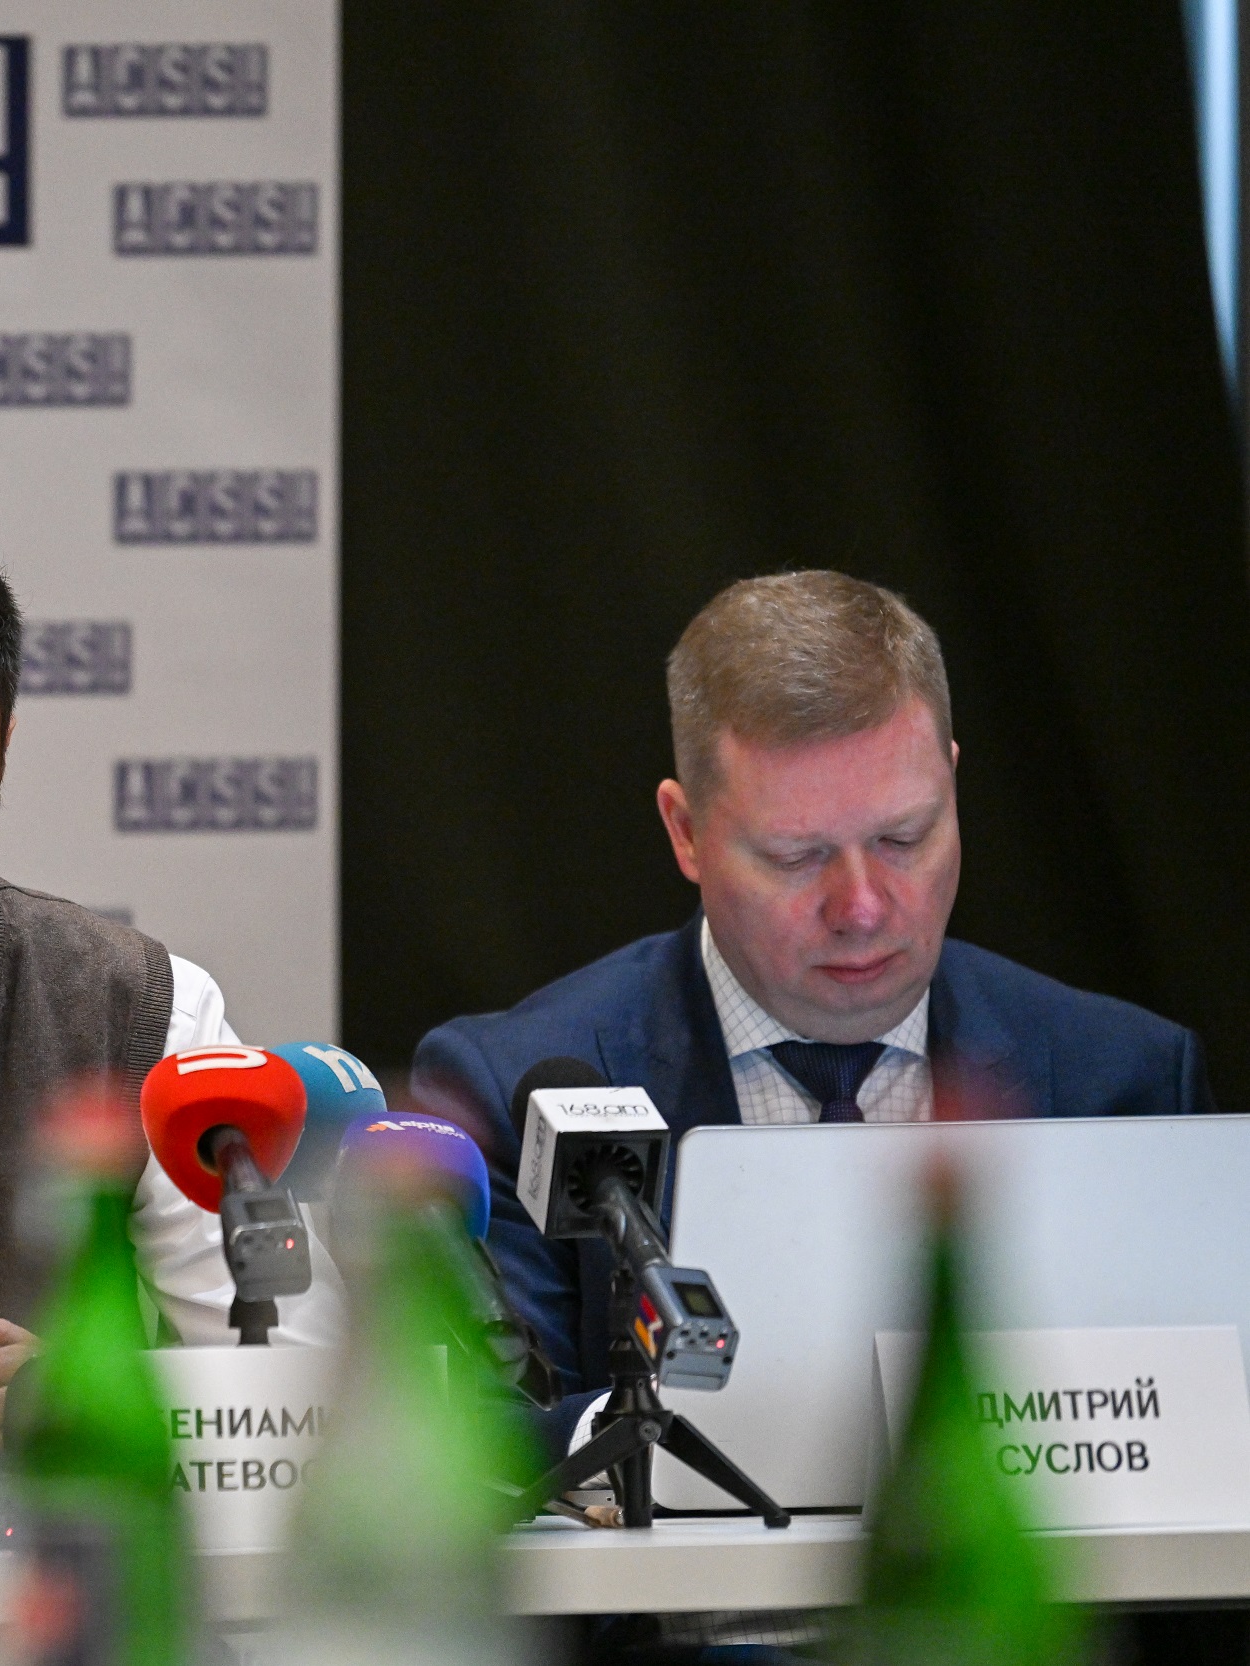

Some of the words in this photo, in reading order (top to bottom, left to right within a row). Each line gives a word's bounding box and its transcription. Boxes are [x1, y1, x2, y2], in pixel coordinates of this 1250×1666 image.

[977, 1376, 1160, 1429] ДМИТРИЙ
[169, 1405, 328, 1440] ЕНИАМ
[996, 1440, 1150, 1476] СУСЛОВ
